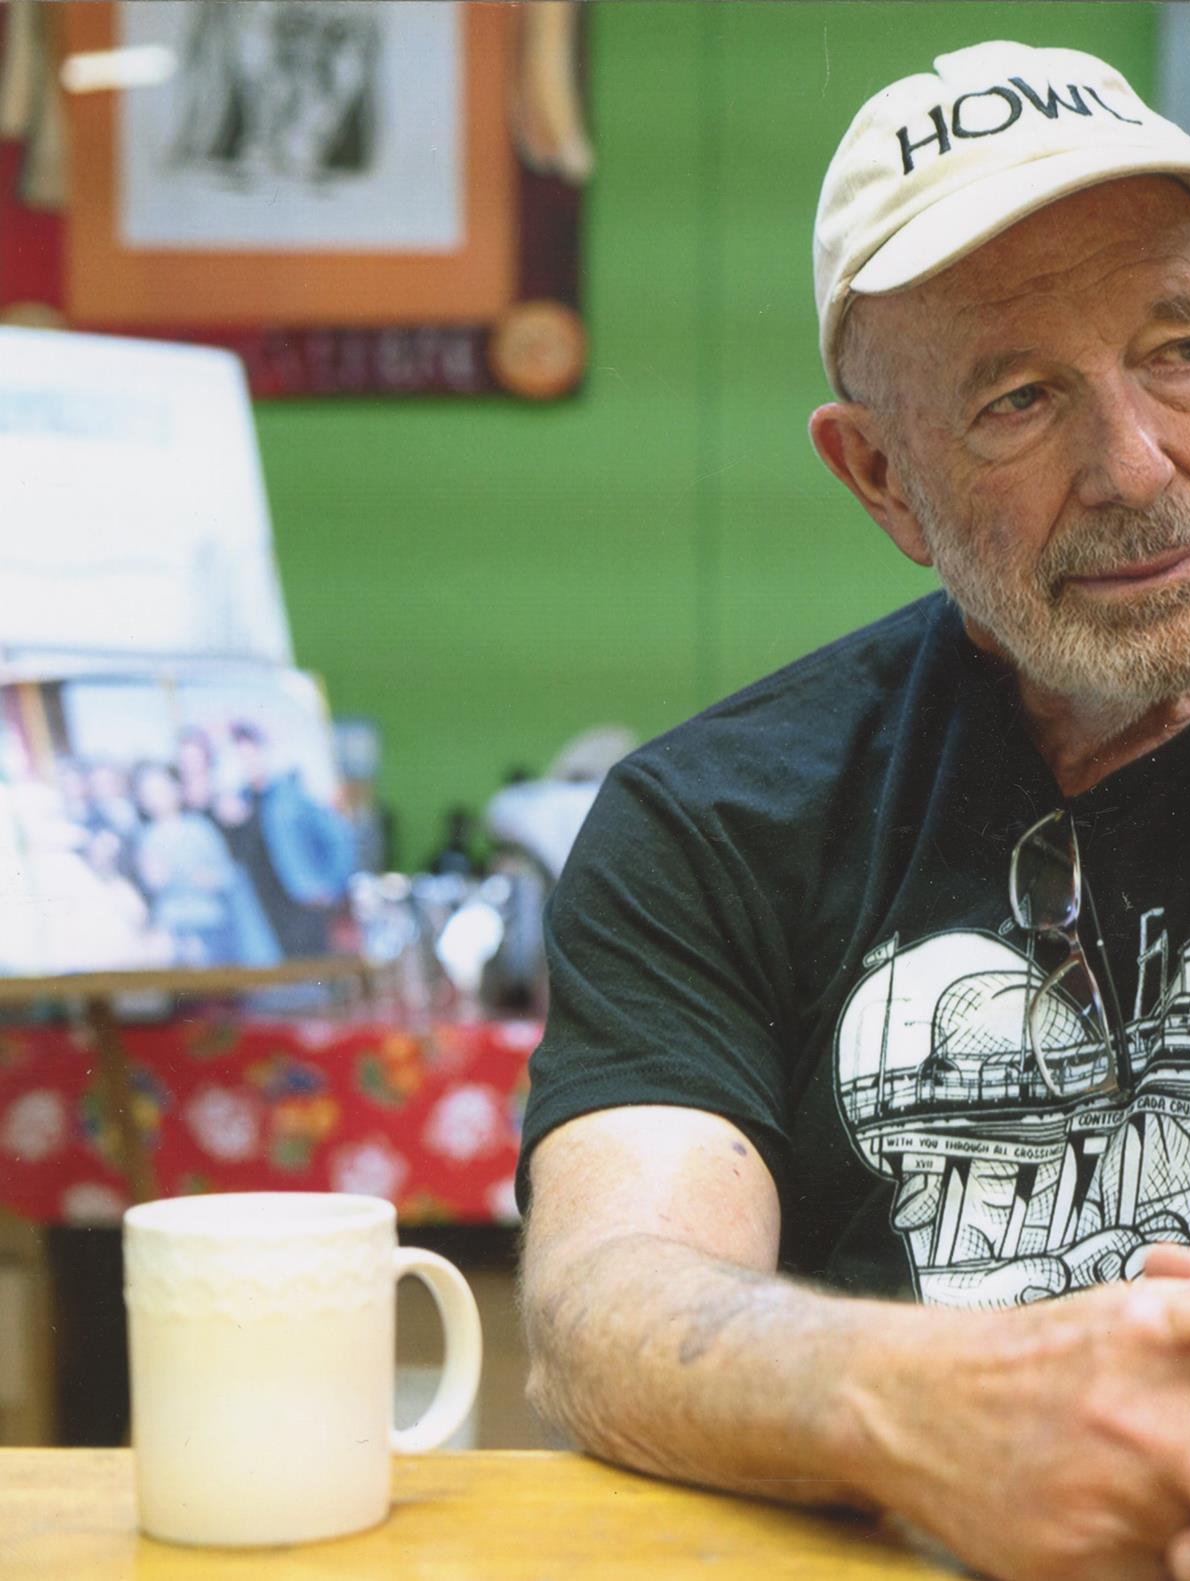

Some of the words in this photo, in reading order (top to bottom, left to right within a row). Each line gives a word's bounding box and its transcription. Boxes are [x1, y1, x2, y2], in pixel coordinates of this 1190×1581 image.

[895, 75, 1144, 177] HOWL
[1136, 1095, 1166, 1111] CADA
[886, 1136, 914, 1148] WITH
[919, 1138, 939, 1149] YOU
[945, 1140, 990, 1154] THROUGH
[993, 1144, 1008, 1156] ALL
